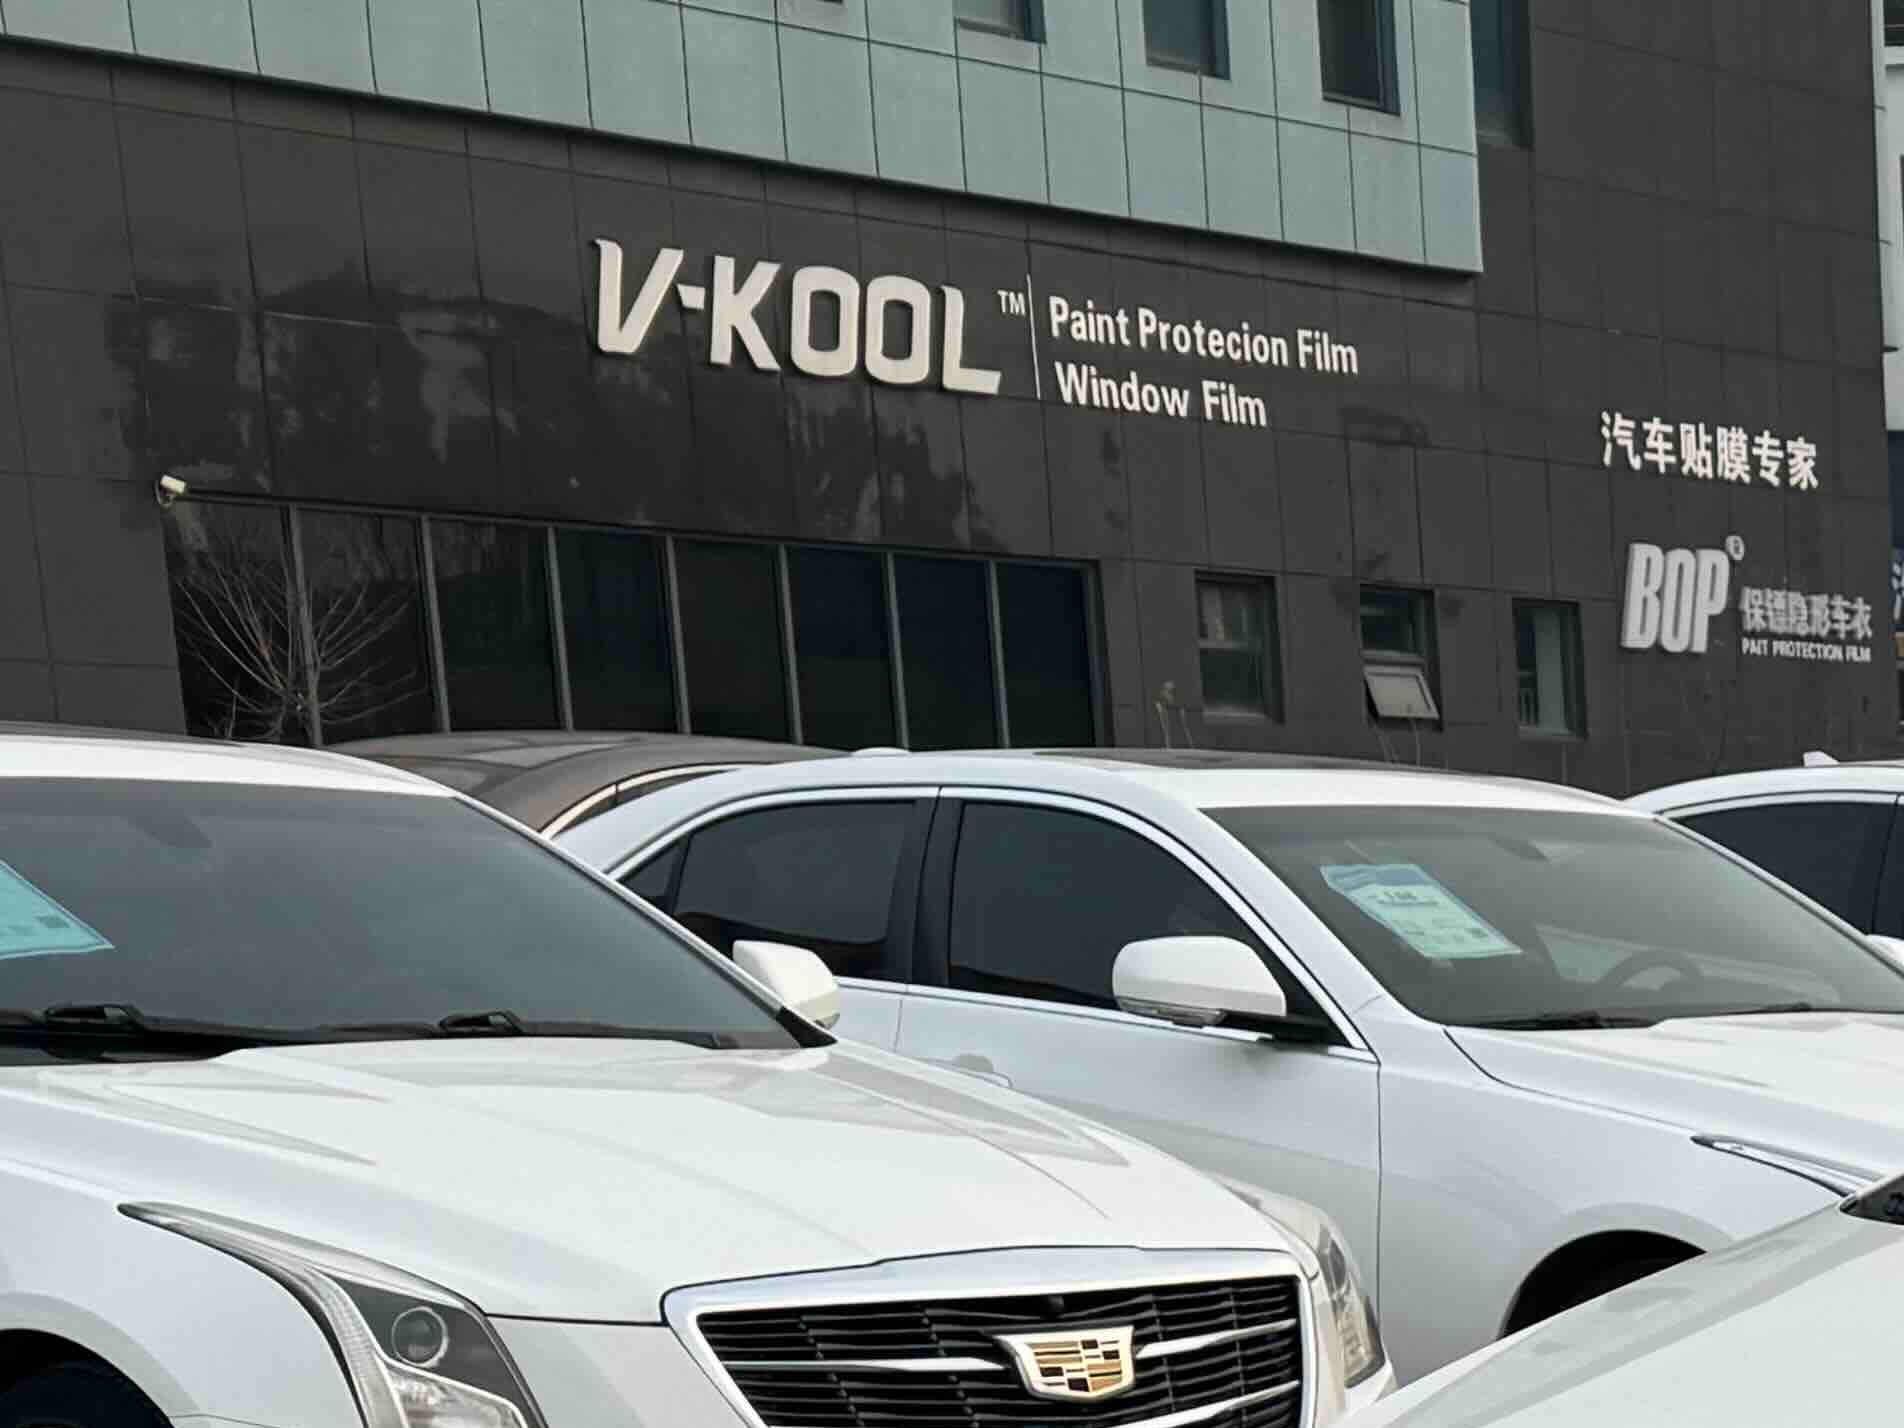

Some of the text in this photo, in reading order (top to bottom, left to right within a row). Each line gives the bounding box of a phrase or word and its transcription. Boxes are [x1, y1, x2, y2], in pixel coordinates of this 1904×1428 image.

[594, 238, 1001, 394] V-KOOL
[1049, 296, 1359, 375] Paint Protecion Film
[1054, 361, 1267, 427] Window Film
[1600, 410, 1819, 490] 汽车贴膜专家
[1621, 542, 1730, 654] BOP
